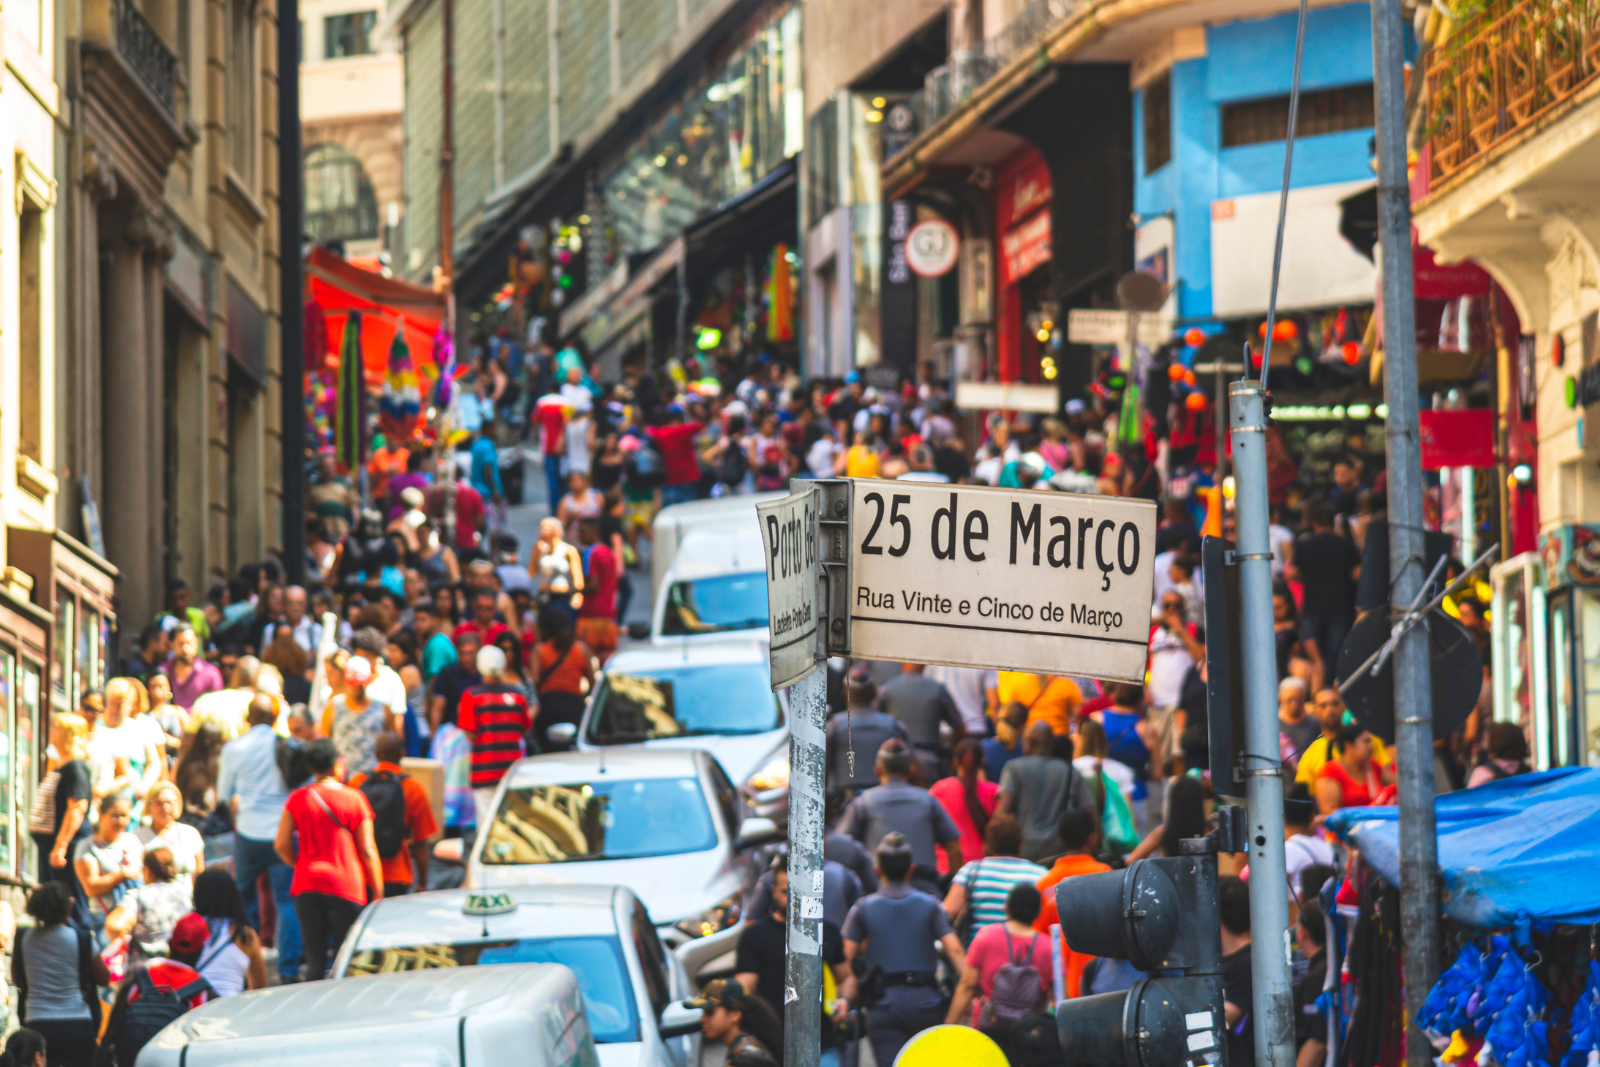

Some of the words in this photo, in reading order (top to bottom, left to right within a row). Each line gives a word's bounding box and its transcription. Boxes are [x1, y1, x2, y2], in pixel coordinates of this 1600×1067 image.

[766, 507, 802, 581] Porto
[860, 492, 911, 558] 25
[930, 492, 988, 562] de
[1009, 501, 1140, 592] Março
[773, 610, 792, 636] Ladeira
[792, 607, 803, 630] Porto
[857, 586, 895, 609] Rua
[901, 590, 952, 614] Vinte
[959, 600, 971, 615] e
[978, 596, 1034, 621] Cinco
[1040, 601, 1065, 623] de
[1070, 602, 1123, 633] Março
[468, 893, 511, 908] TAXI
